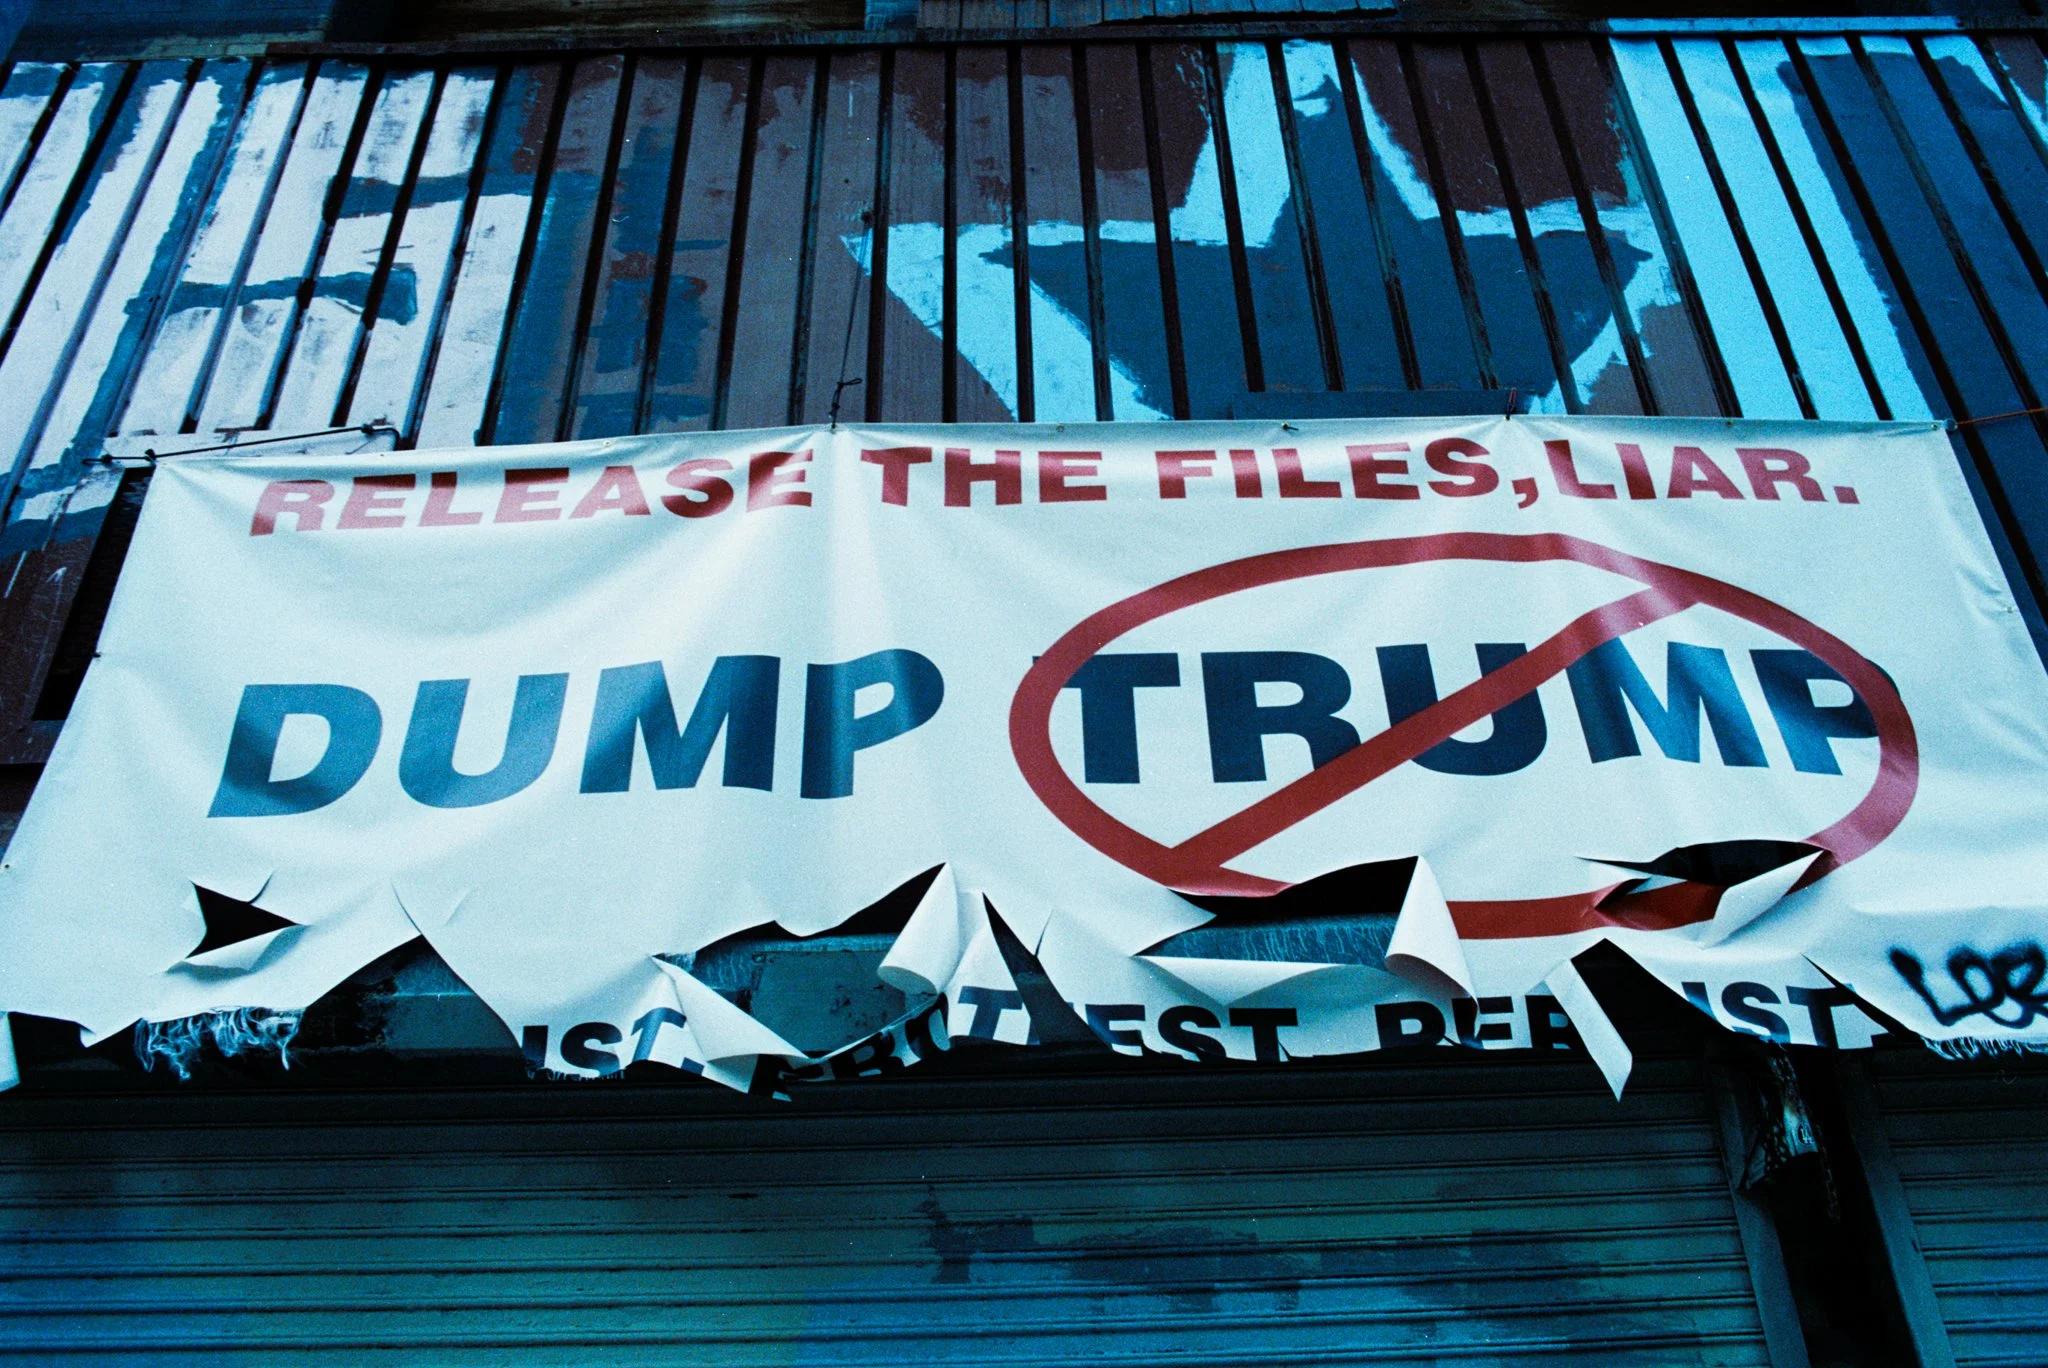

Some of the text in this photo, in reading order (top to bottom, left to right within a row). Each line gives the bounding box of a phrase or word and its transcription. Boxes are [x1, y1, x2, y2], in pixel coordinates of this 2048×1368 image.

[251, 448, 813, 536] RELEASE
[860, 446, 1106, 507] THE
[207, 648, 945, 818] DUMP
[1033, 642, 1902, 785] TRUMP
